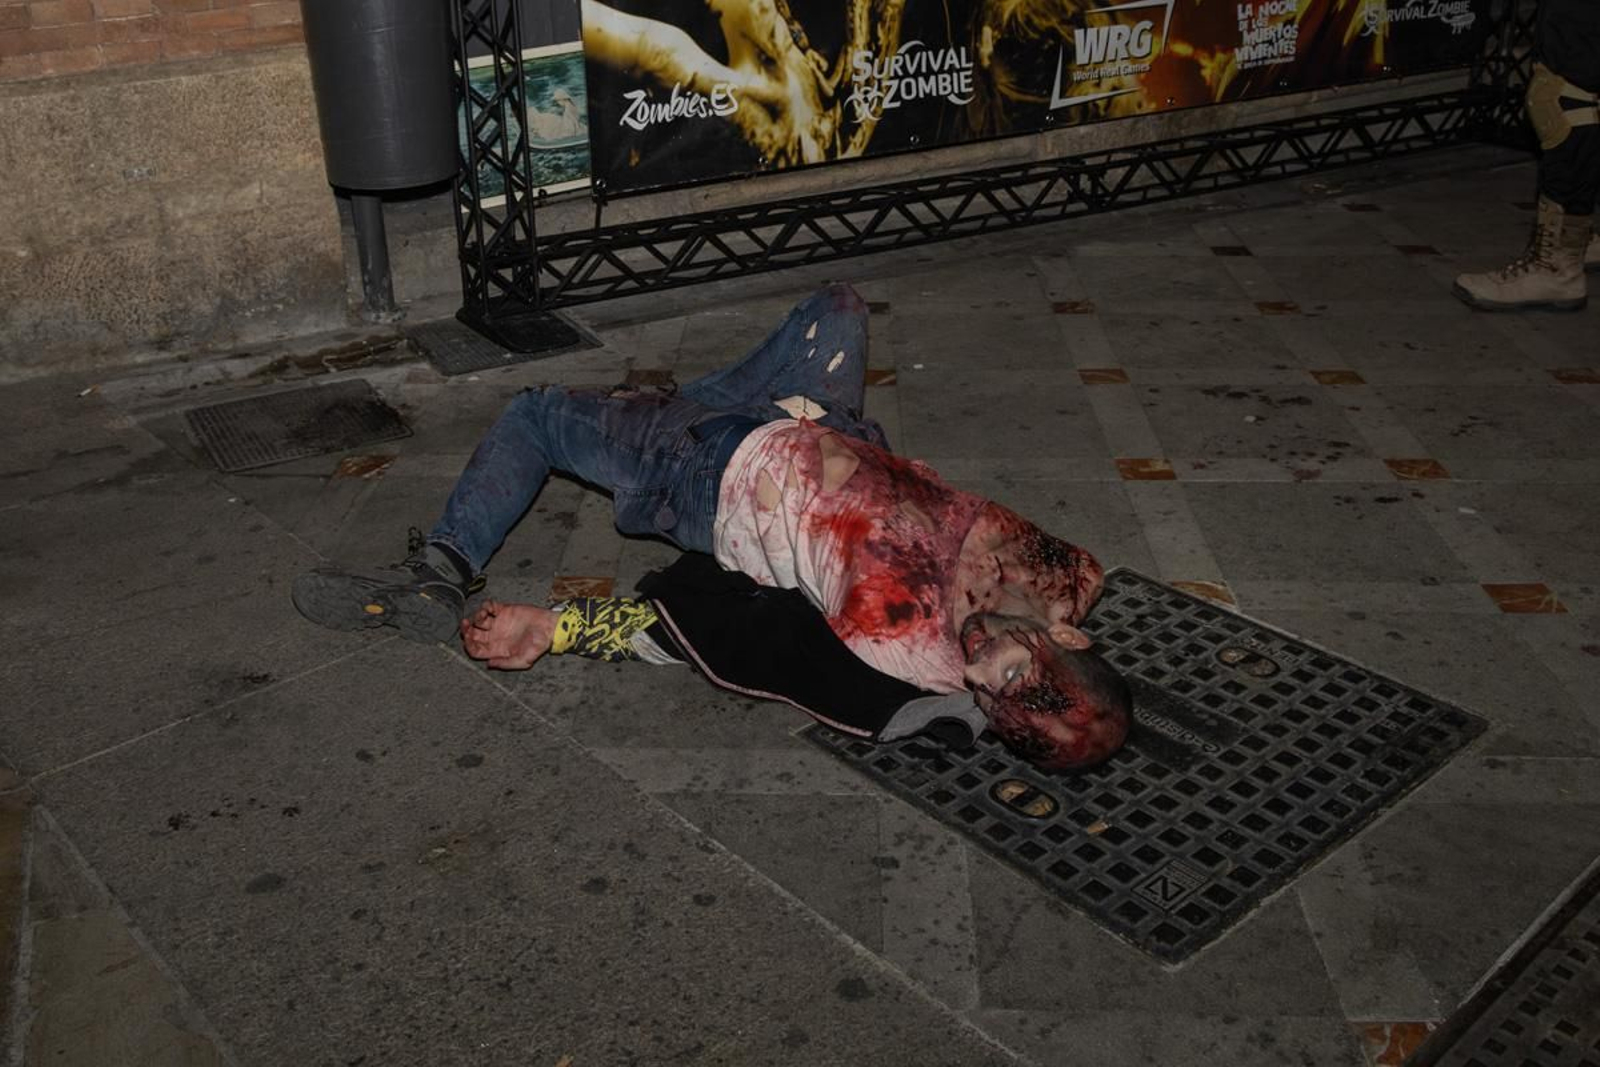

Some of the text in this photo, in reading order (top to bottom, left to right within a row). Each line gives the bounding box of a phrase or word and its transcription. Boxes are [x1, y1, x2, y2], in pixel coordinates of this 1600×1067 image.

[1237, 3, 1253, 20] LA
[1073, 20, 1154, 65] WRG
[1242, 22, 1299, 45] MUERTOS
[1234, 39, 1297, 62] VIVIENTES
[852, 45, 974, 82] SURVIVAL
[1072, 68, 1099, 81] World
[882, 69, 974, 109] ZOMBIE
